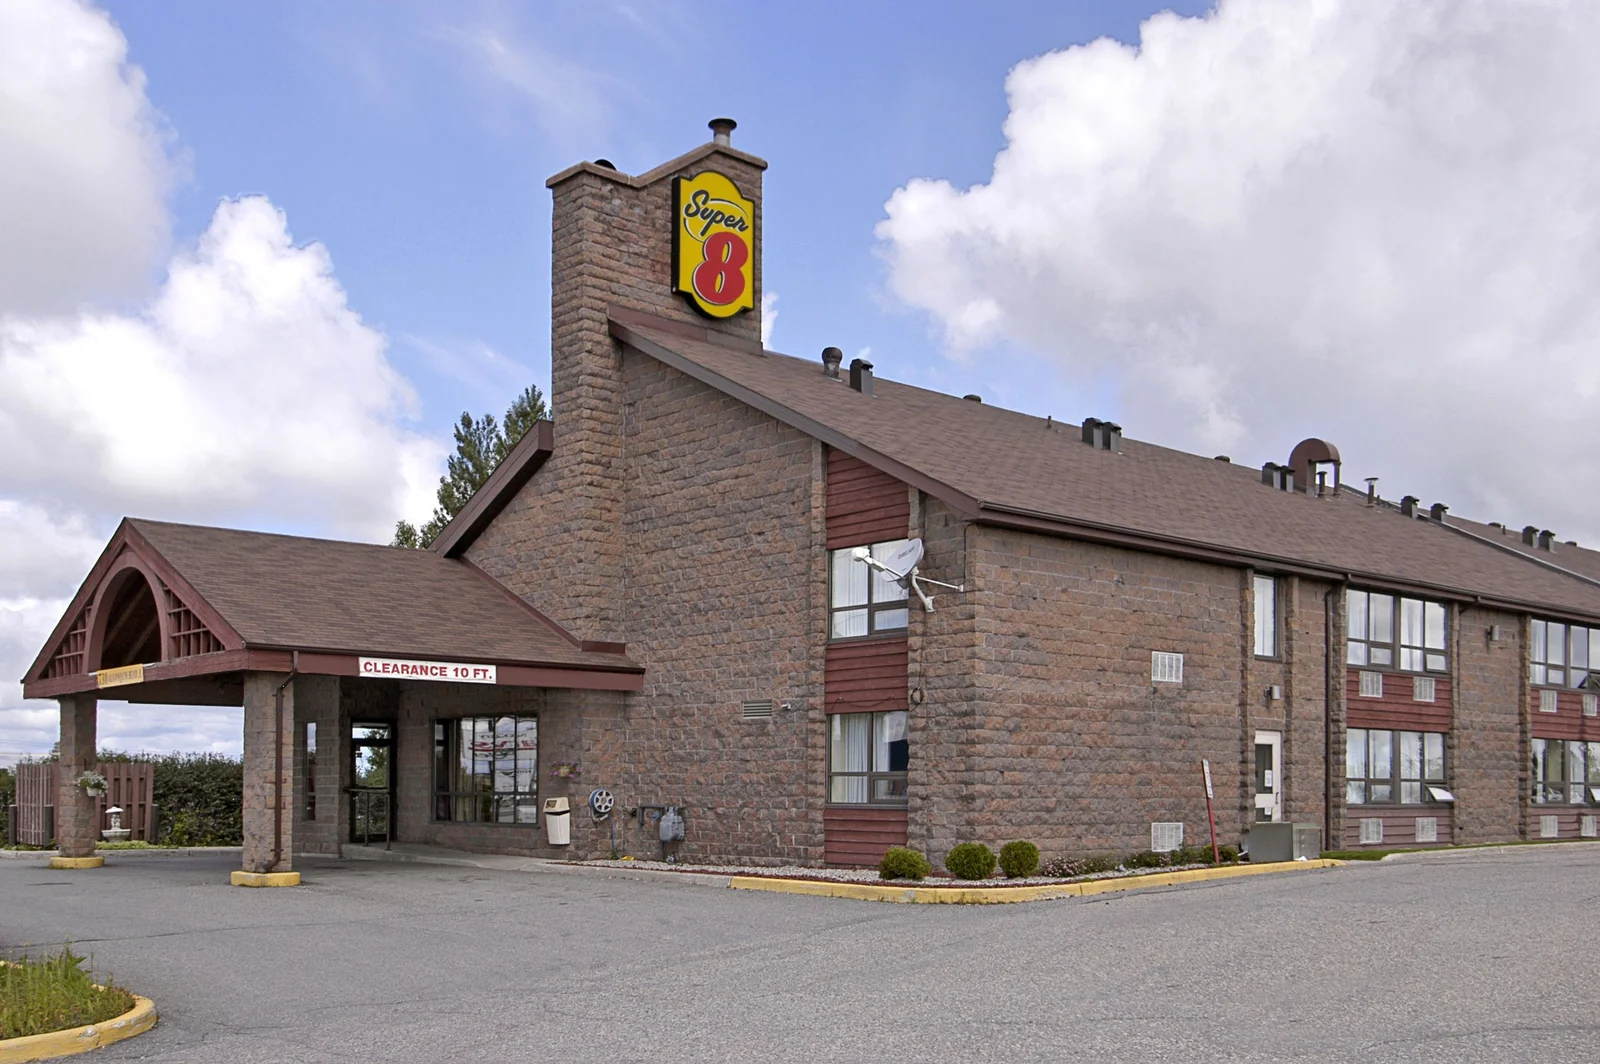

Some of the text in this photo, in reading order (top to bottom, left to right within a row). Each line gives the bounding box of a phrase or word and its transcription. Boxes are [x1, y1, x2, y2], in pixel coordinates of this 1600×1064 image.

[684, 189, 749, 237] Super
[691, 231, 749, 306] 8
[363, 661, 493, 680] CLEARANCE 10 FT.
